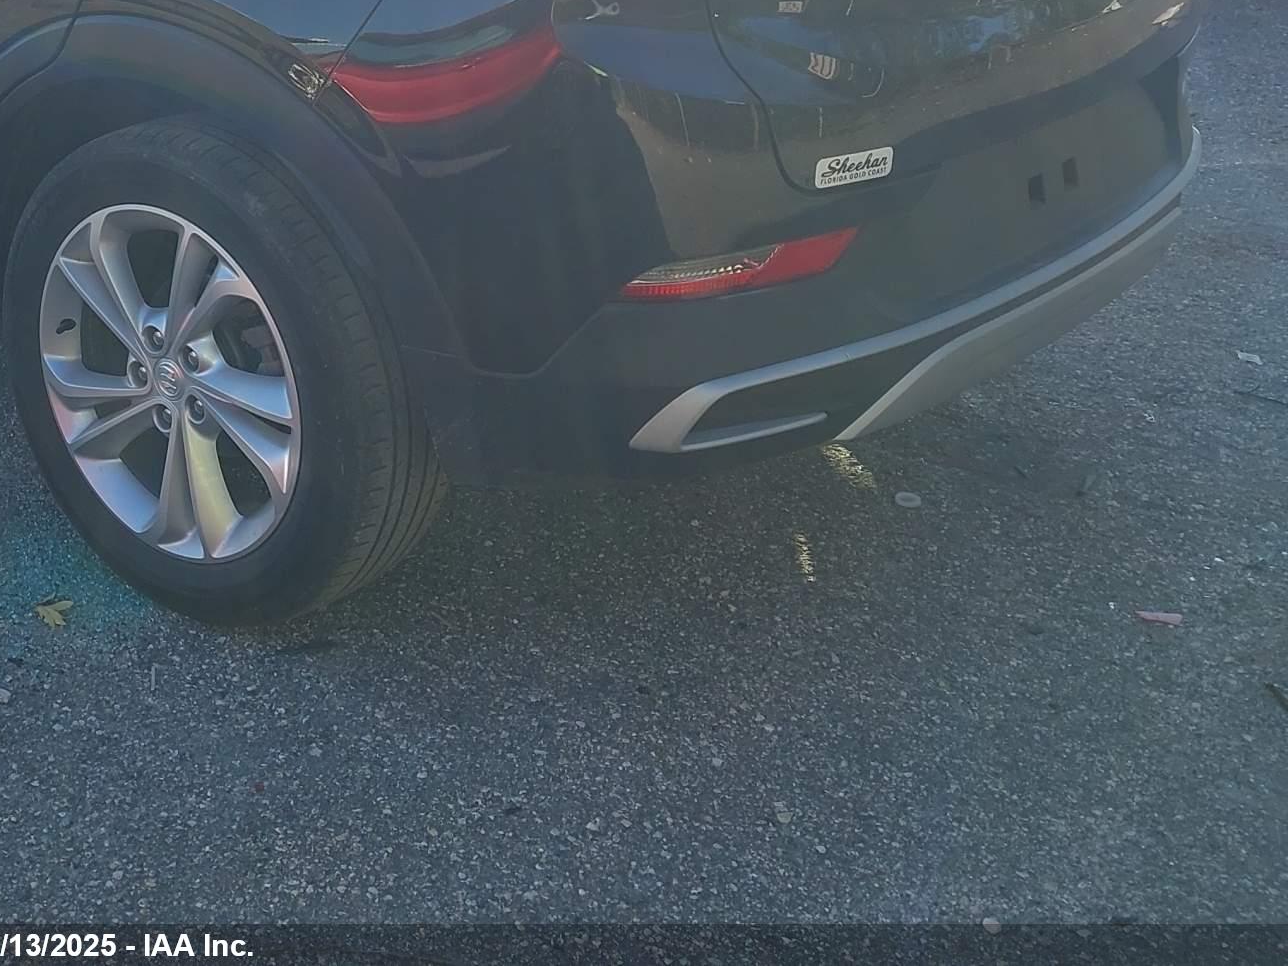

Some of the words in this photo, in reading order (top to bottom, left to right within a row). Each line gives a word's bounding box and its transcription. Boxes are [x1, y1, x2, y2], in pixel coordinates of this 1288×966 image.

[820, 175, 848, 185] FLORIDA
[849, 170, 867, 180] GOLD
[868, 166, 887, 177] COAST
[821, 152, 888, 178] Sheehan
